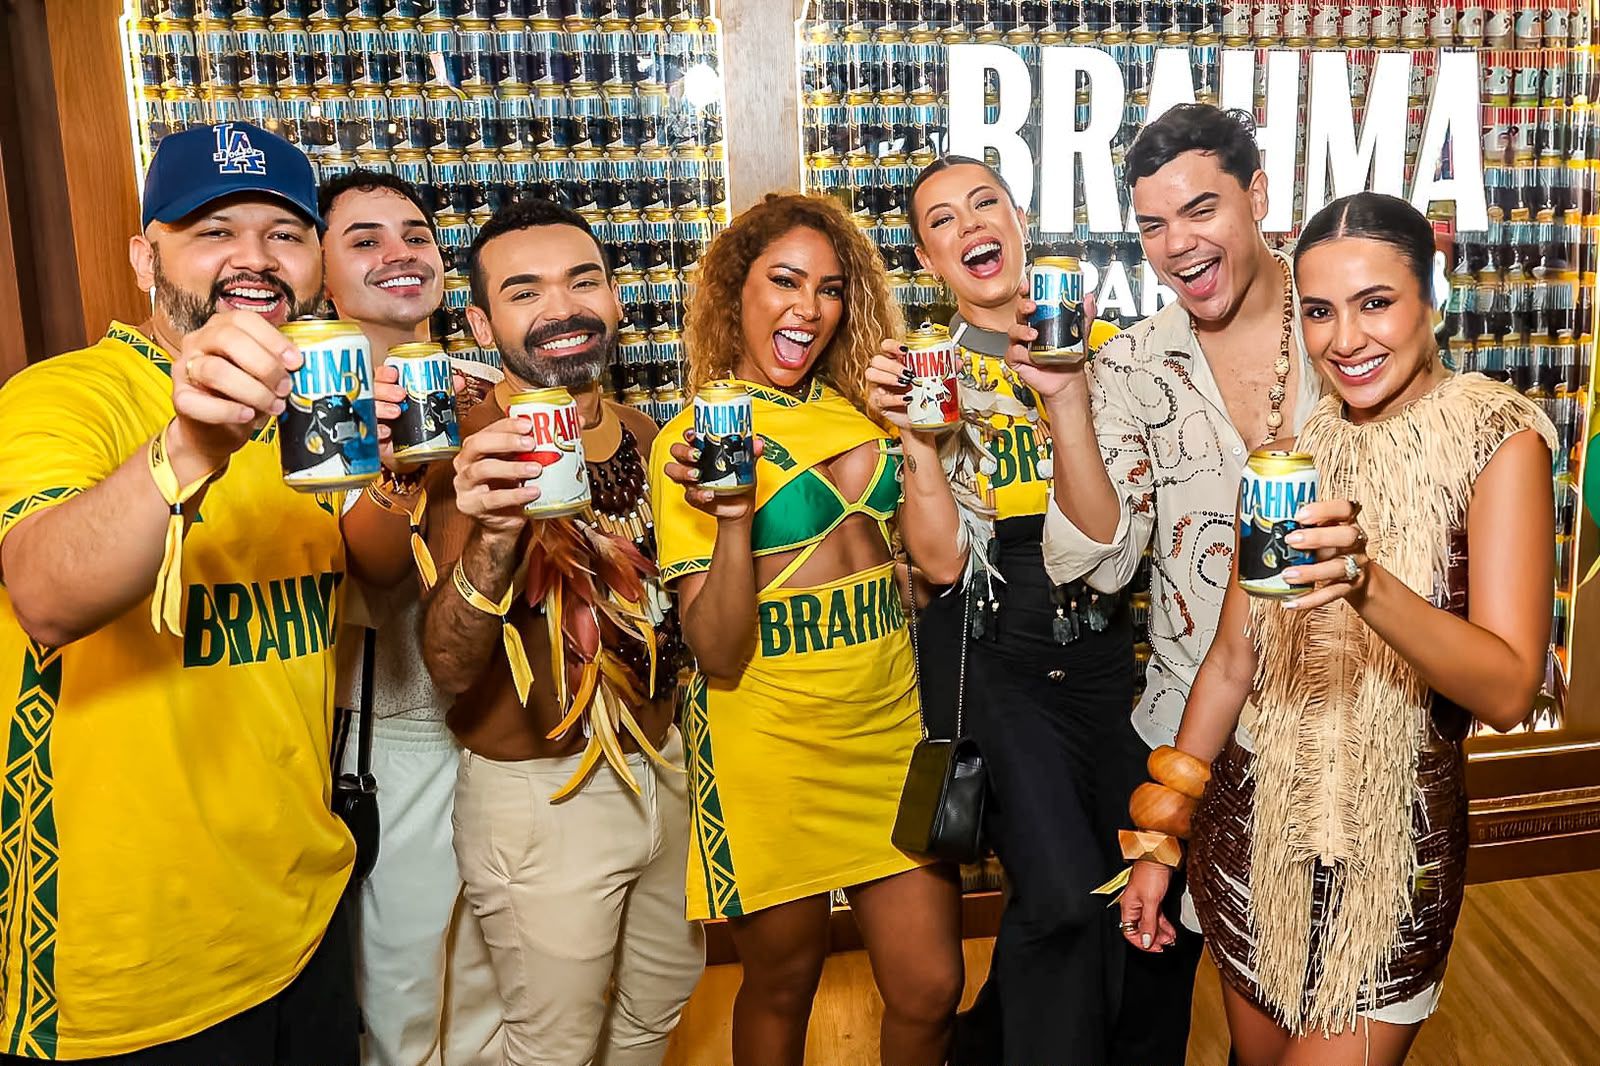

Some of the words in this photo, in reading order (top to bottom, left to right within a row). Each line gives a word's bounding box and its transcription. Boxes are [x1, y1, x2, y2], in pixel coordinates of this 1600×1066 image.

[948, 43, 1487, 234] BRAHMA
[1034, 273, 1084, 301] BRAH
[389, 360, 450, 392] AHM
[517, 407, 579, 446] RAH
[694, 405, 752, 434] RAHMA
